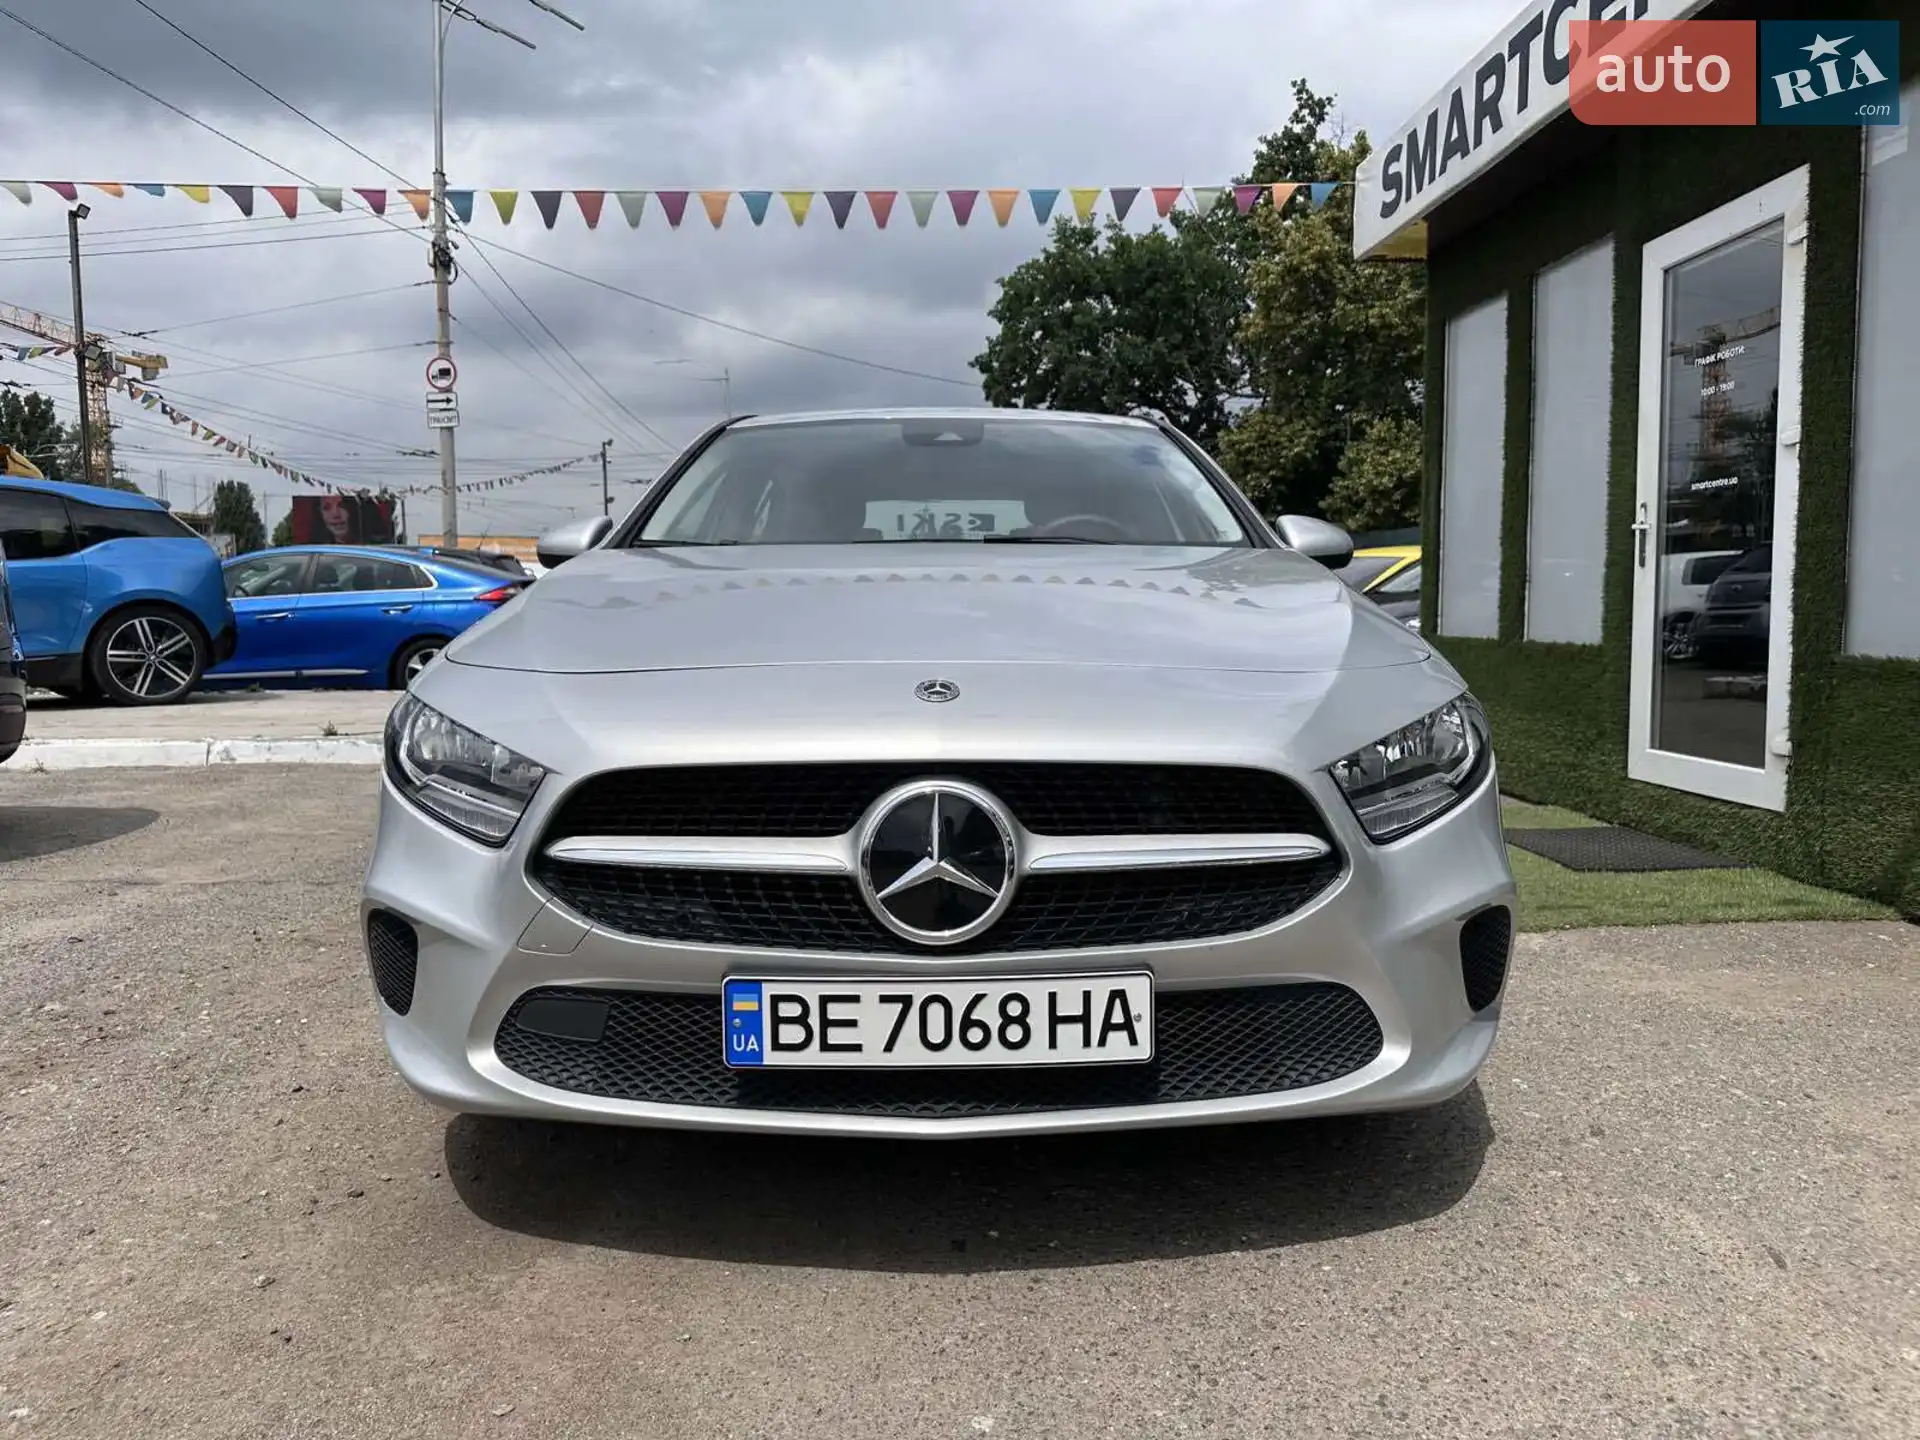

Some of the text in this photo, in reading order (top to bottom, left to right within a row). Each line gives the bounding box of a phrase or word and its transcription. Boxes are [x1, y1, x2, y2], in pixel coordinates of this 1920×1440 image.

[769, 988, 1139, 1053] BE 7068 HA
[732, 1034, 759, 1052] UA
